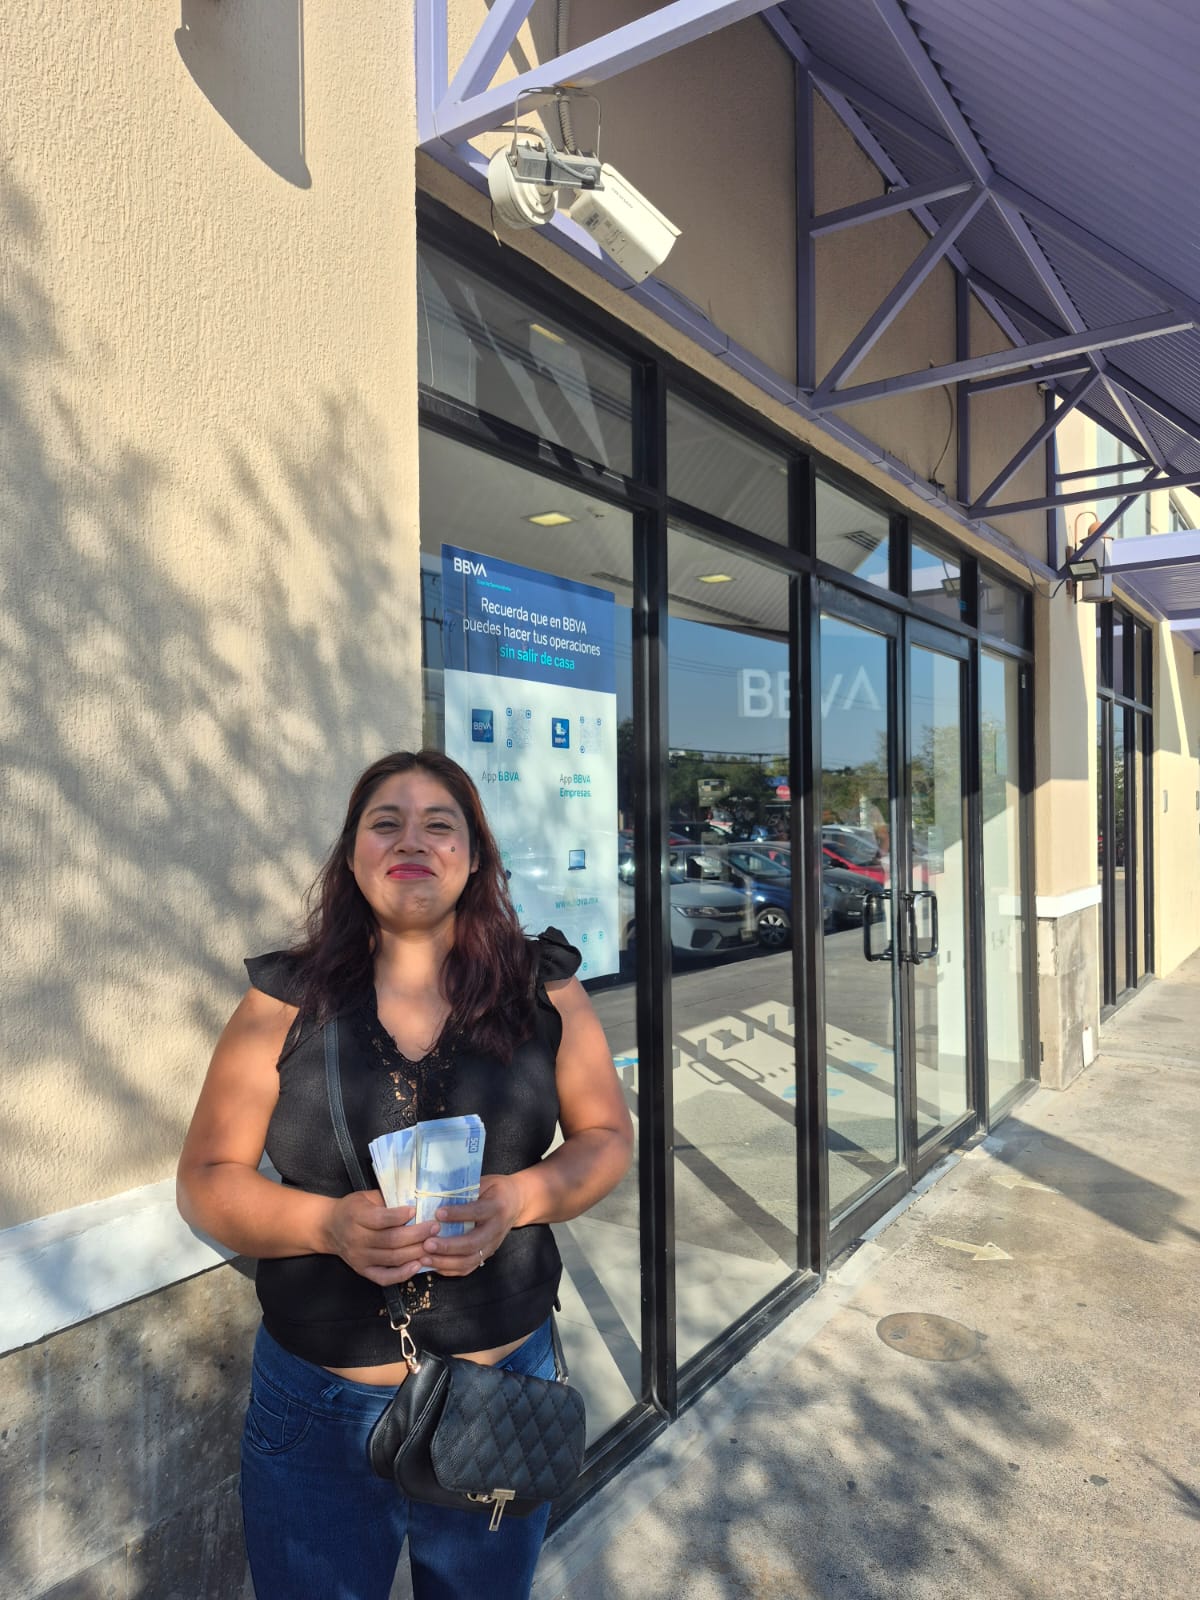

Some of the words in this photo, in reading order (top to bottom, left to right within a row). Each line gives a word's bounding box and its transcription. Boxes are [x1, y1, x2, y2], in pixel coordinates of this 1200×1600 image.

[453, 557, 487, 577] BBVA
[481, 597, 529, 622] Recuerda
[530, 610, 548, 627] que
[550, 616, 561, 629] en
[562, 616, 587, 634] BBVA
[463, 617, 501, 635] puedes
[503, 623, 530, 642] hacer
[533, 630, 548, 646] tus
[550, 635, 601, 656] operaciones
[500, 643, 515, 659] sin
[517, 645, 538, 663] salir
[540, 650, 552, 666] de
[554, 655, 575, 670] casa
[481, 769, 497, 785] App
[559, 773, 572, 785] App
